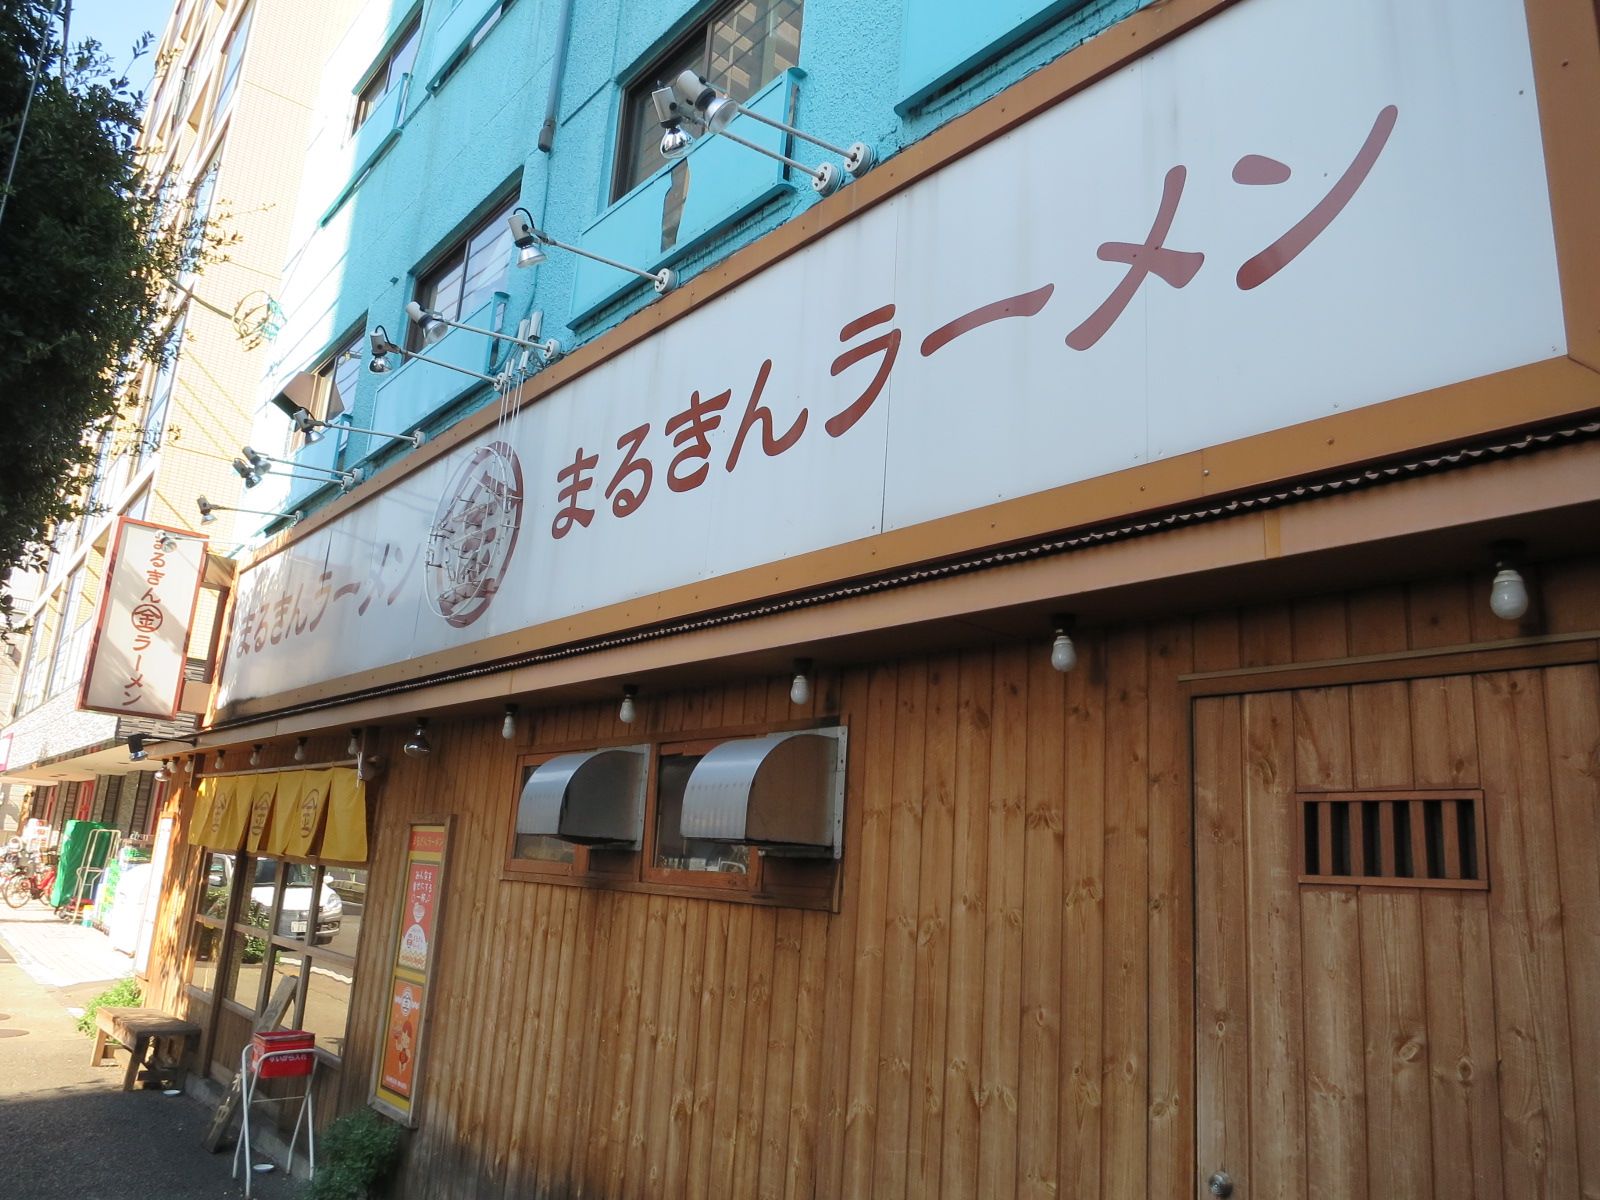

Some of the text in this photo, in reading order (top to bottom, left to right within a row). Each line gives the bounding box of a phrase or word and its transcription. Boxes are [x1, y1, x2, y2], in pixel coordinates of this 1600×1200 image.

[550, 104, 1400, 540] まるきんラーメン
[236, 543, 421, 659] まるきんラーメン
